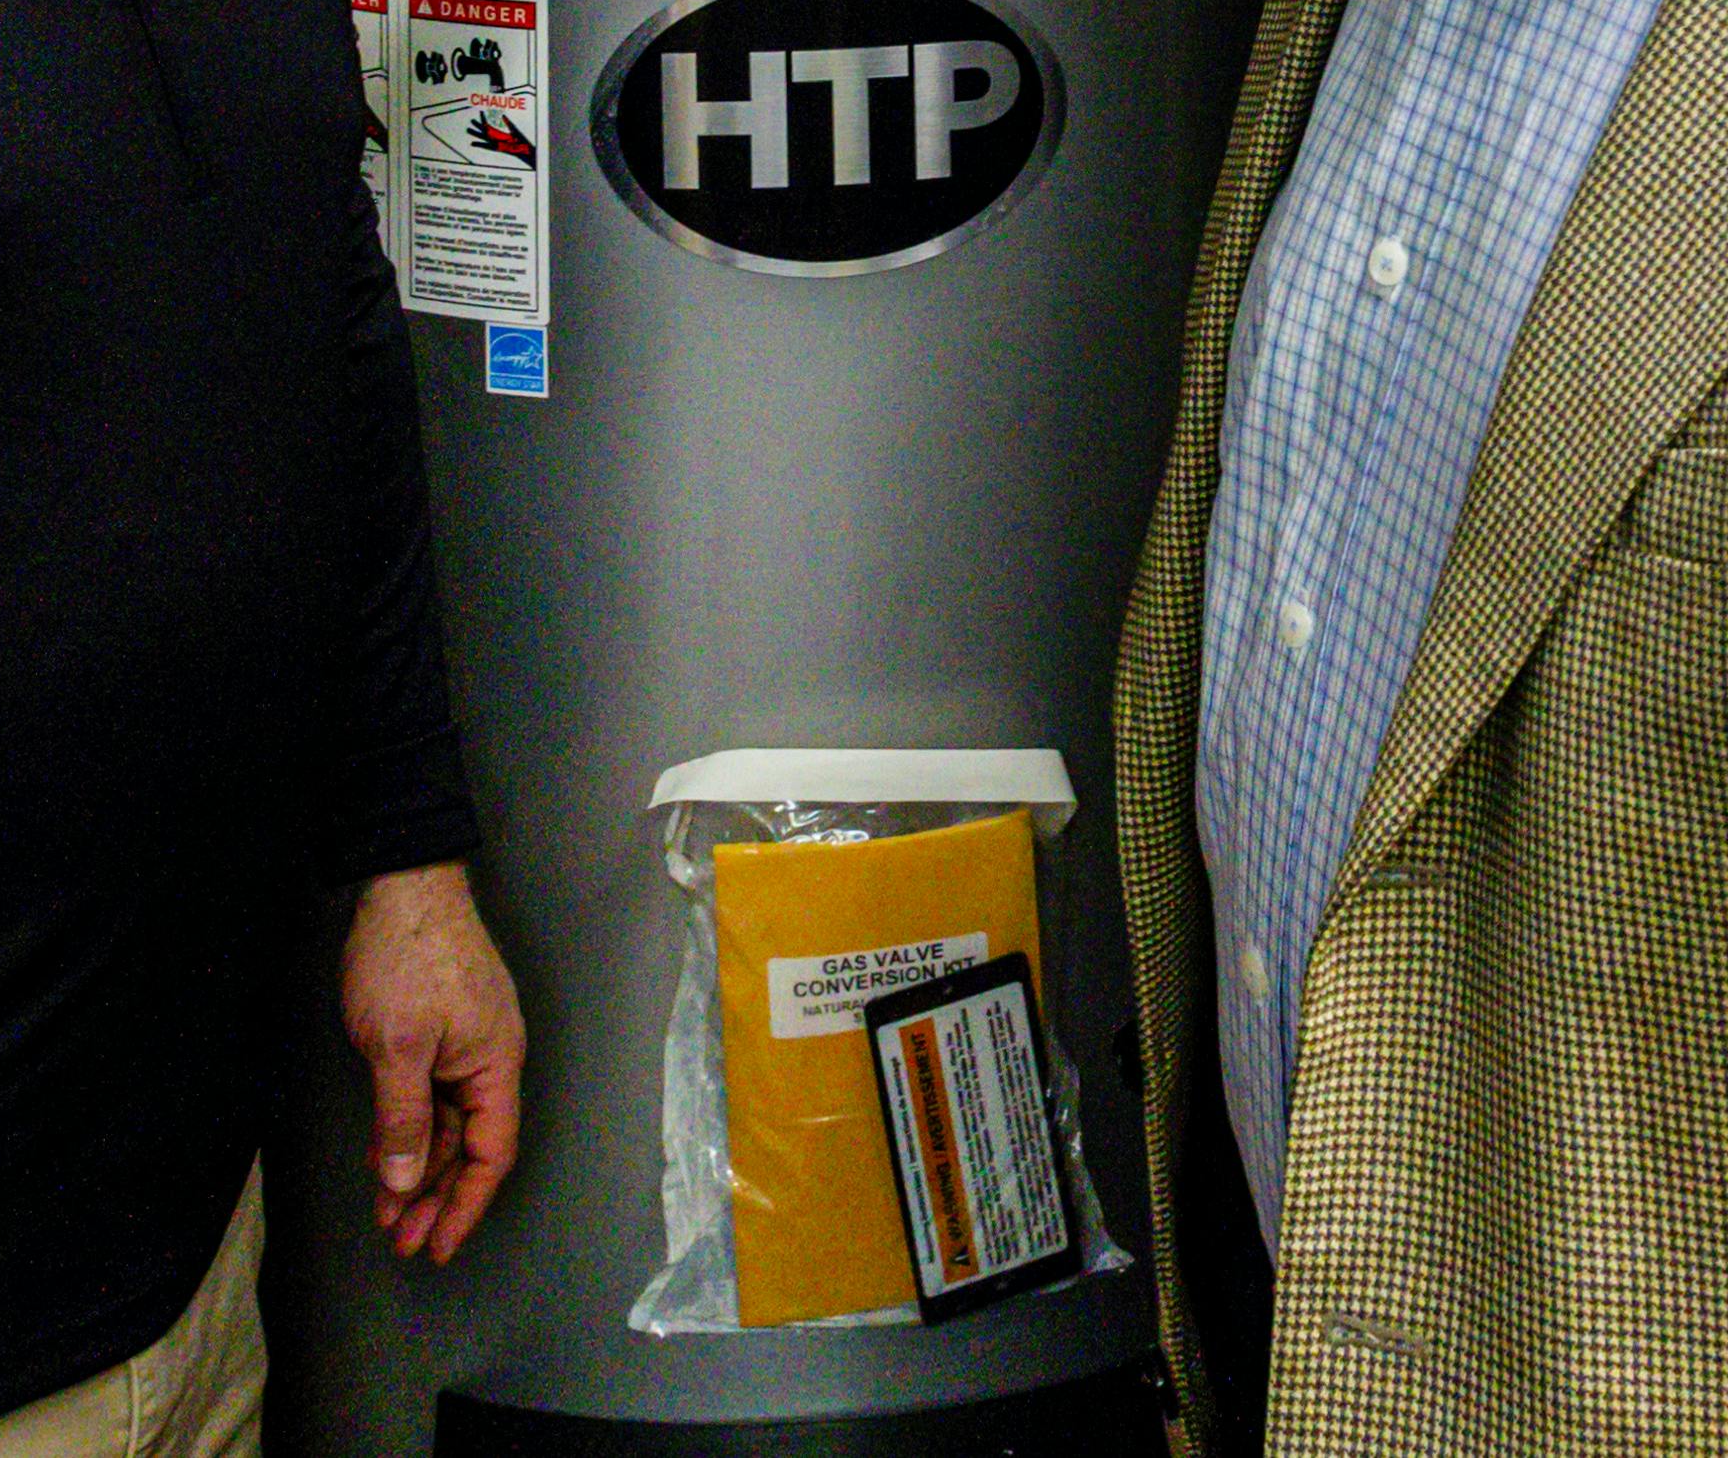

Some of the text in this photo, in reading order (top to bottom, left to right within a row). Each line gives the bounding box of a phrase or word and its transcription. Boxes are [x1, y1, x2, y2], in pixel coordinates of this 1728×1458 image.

[440, 1, 527, 24] DANGER
[469, 93, 527, 110] CHAUDE
[661, 40, 1021, 189] HTP
[823, 943, 945, 975] GAS VALVE
[793, 964, 938, 998] CONVERSION
